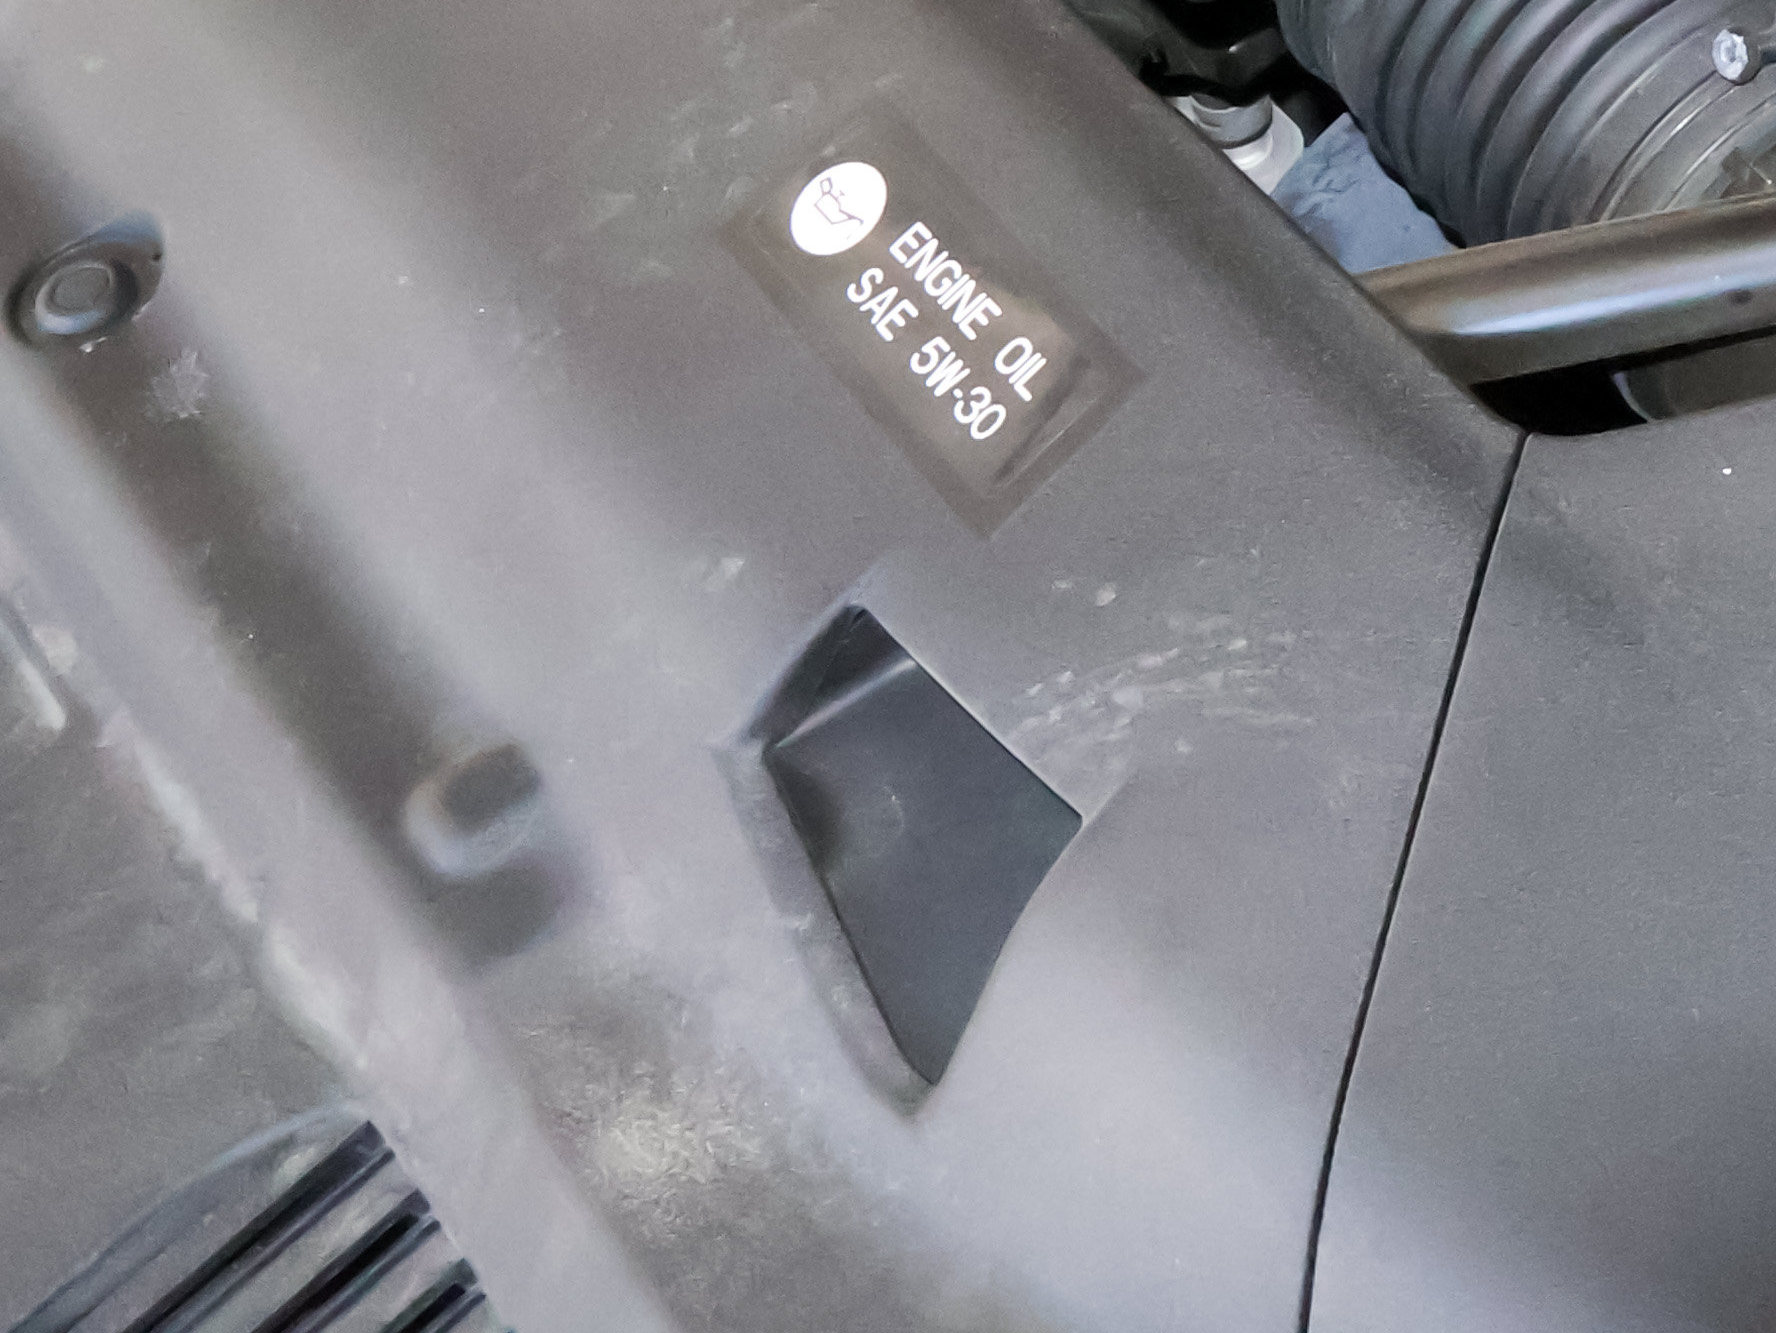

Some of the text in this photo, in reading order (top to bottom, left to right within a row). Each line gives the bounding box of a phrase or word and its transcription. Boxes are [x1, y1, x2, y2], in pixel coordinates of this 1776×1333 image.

[846, 268, 1006, 440] SAE 5W-30
[889, 222, 1047, 401] ENGINE OIL
